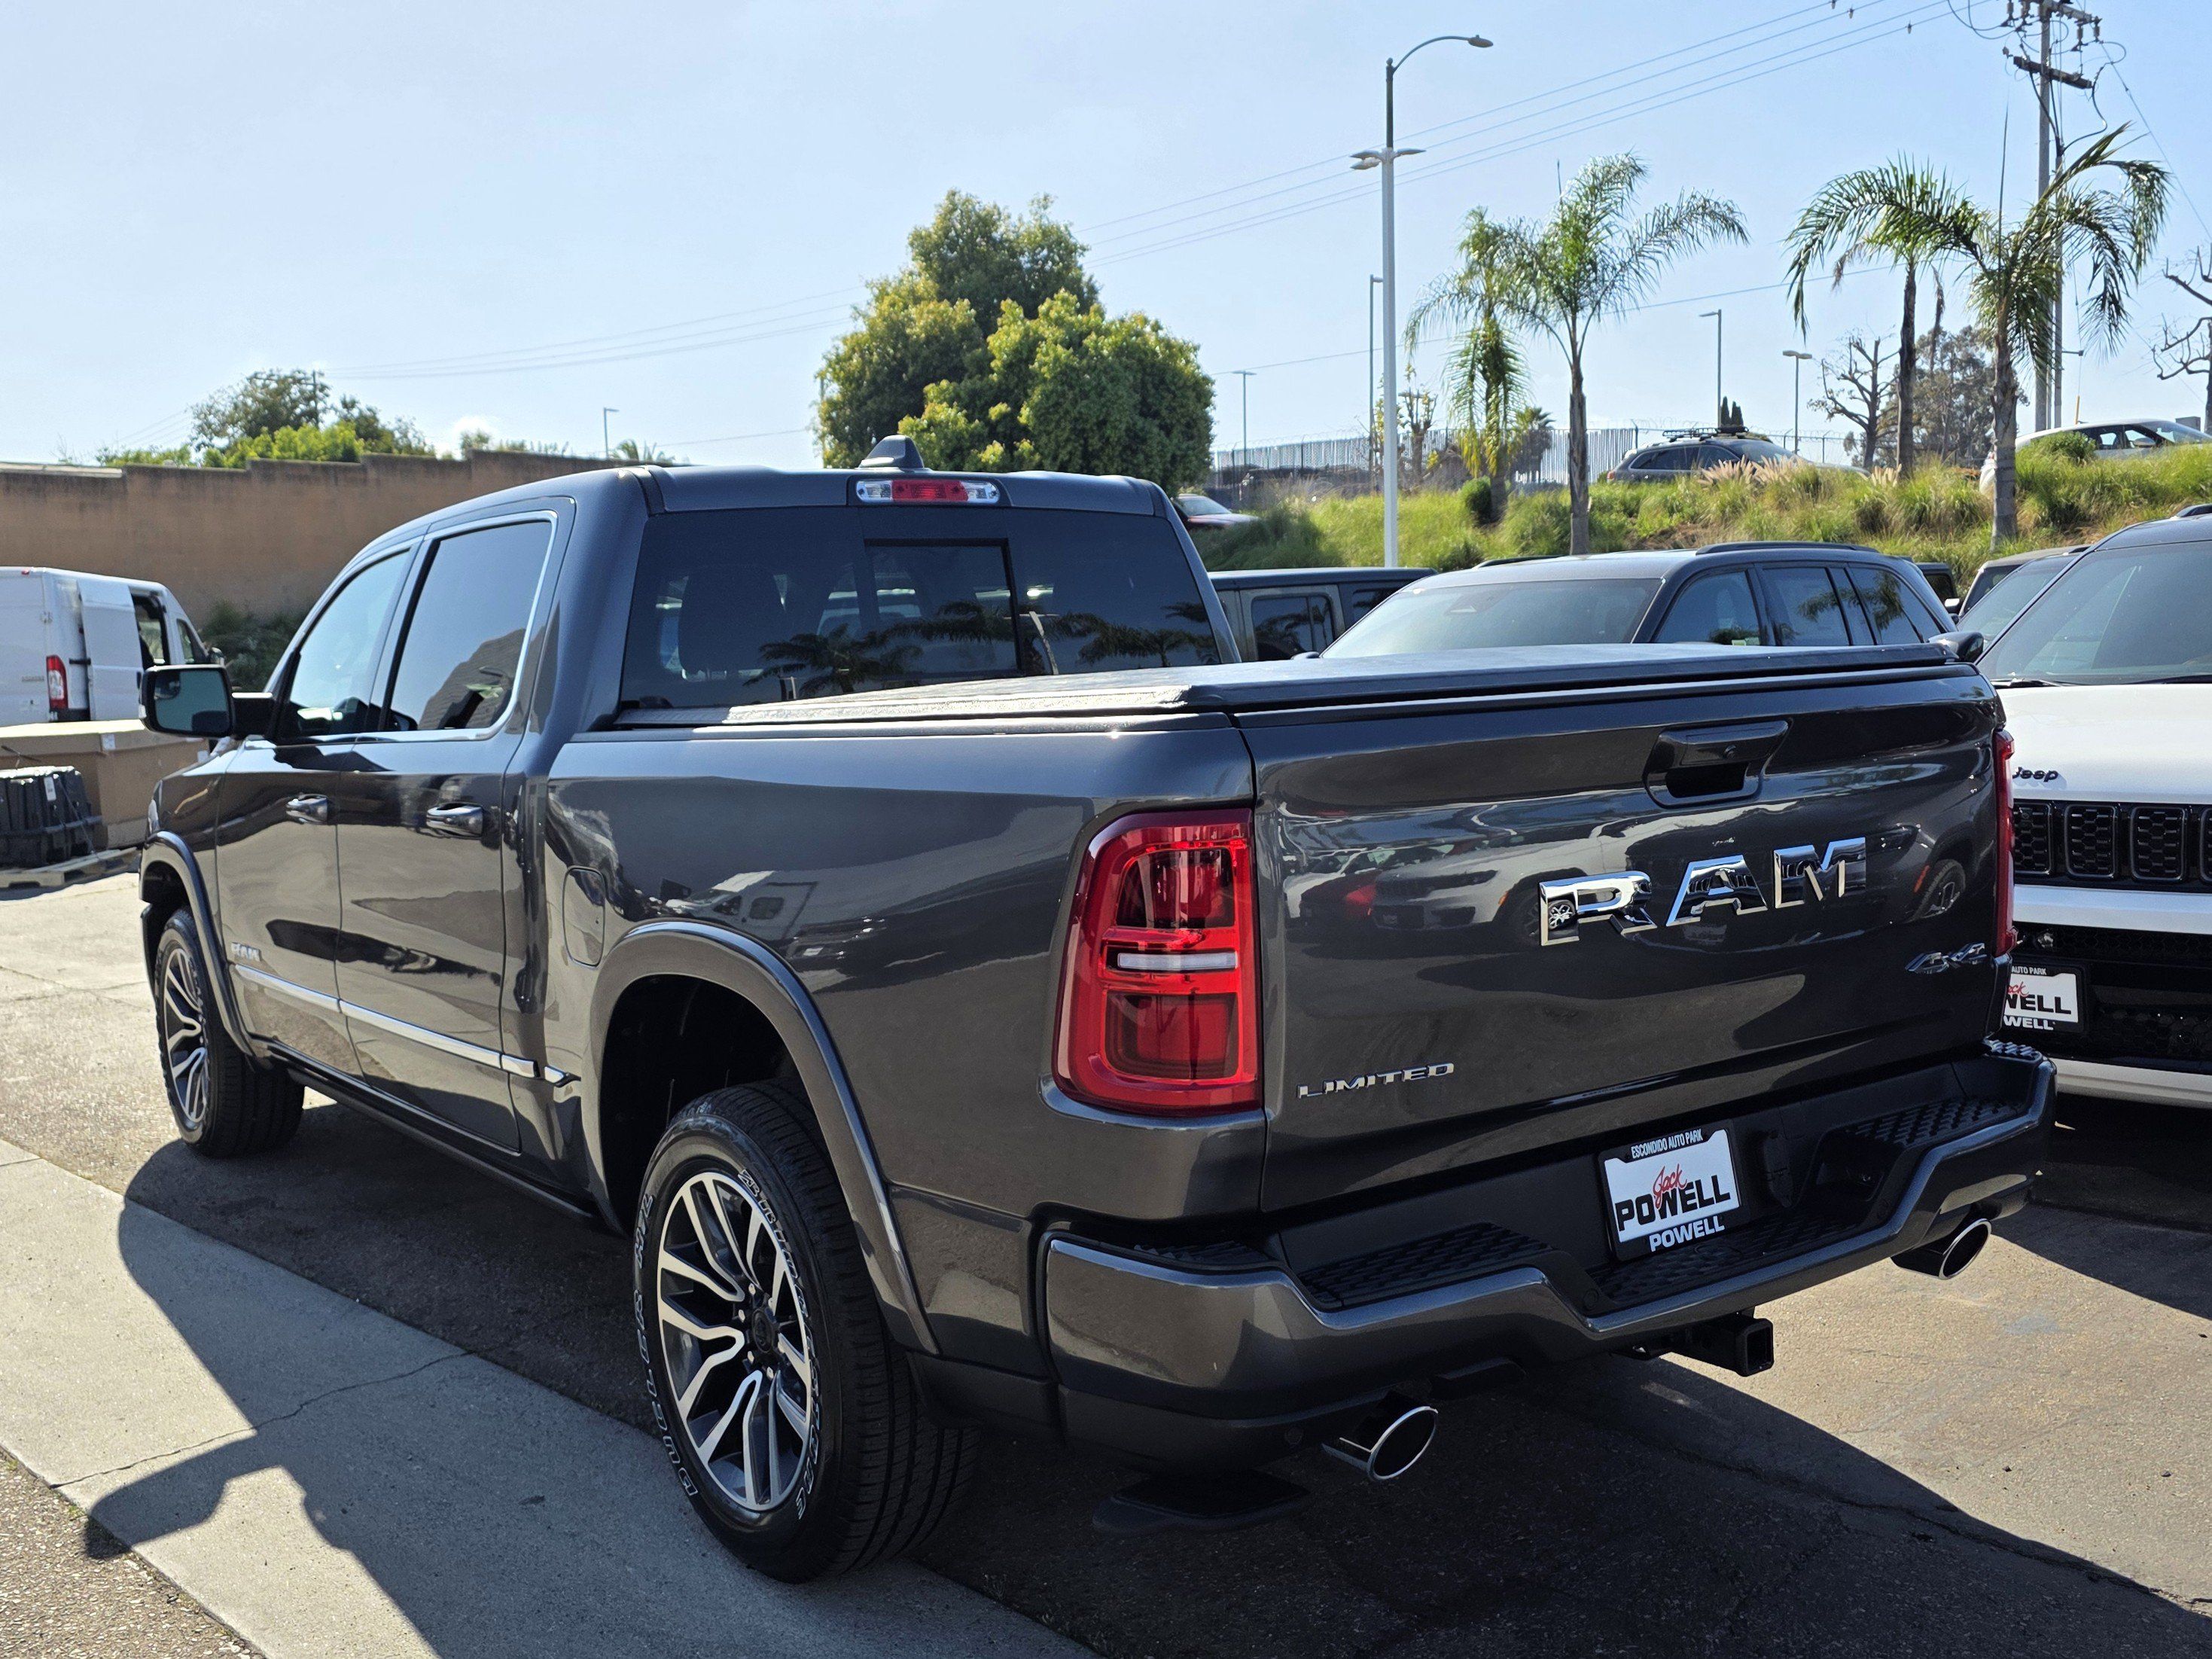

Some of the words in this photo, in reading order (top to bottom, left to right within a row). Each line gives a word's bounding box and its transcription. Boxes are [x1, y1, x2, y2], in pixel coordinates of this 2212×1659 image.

[2012, 766, 2059, 782] Jeep
[1540, 837, 1866, 947] RAM
[230, 941, 262, 962] RAM
[2011, 965, 2029, 974] AUTO
[2029, 967, 2047, 976] PARK
[2004, 993, 2072, 1015] WELL
[2003, 1014, 2054, 1031] WELL
[1296, 1062, 1455, 1099] LIMITED
[1631, 1137, 1668, 1160] ESCONDIDO
[1668, 1133, 1686, 1150] AUTO
[1684, 1128, 1704, 1145] PARK
[1614, 1174, 1732, 1232] POWELL
[1653, 1163, 1688, 1209] Jack
[1649, 1215, 1726, 1252] POWELL
[633, 1288, 699, 1497] DUELER
